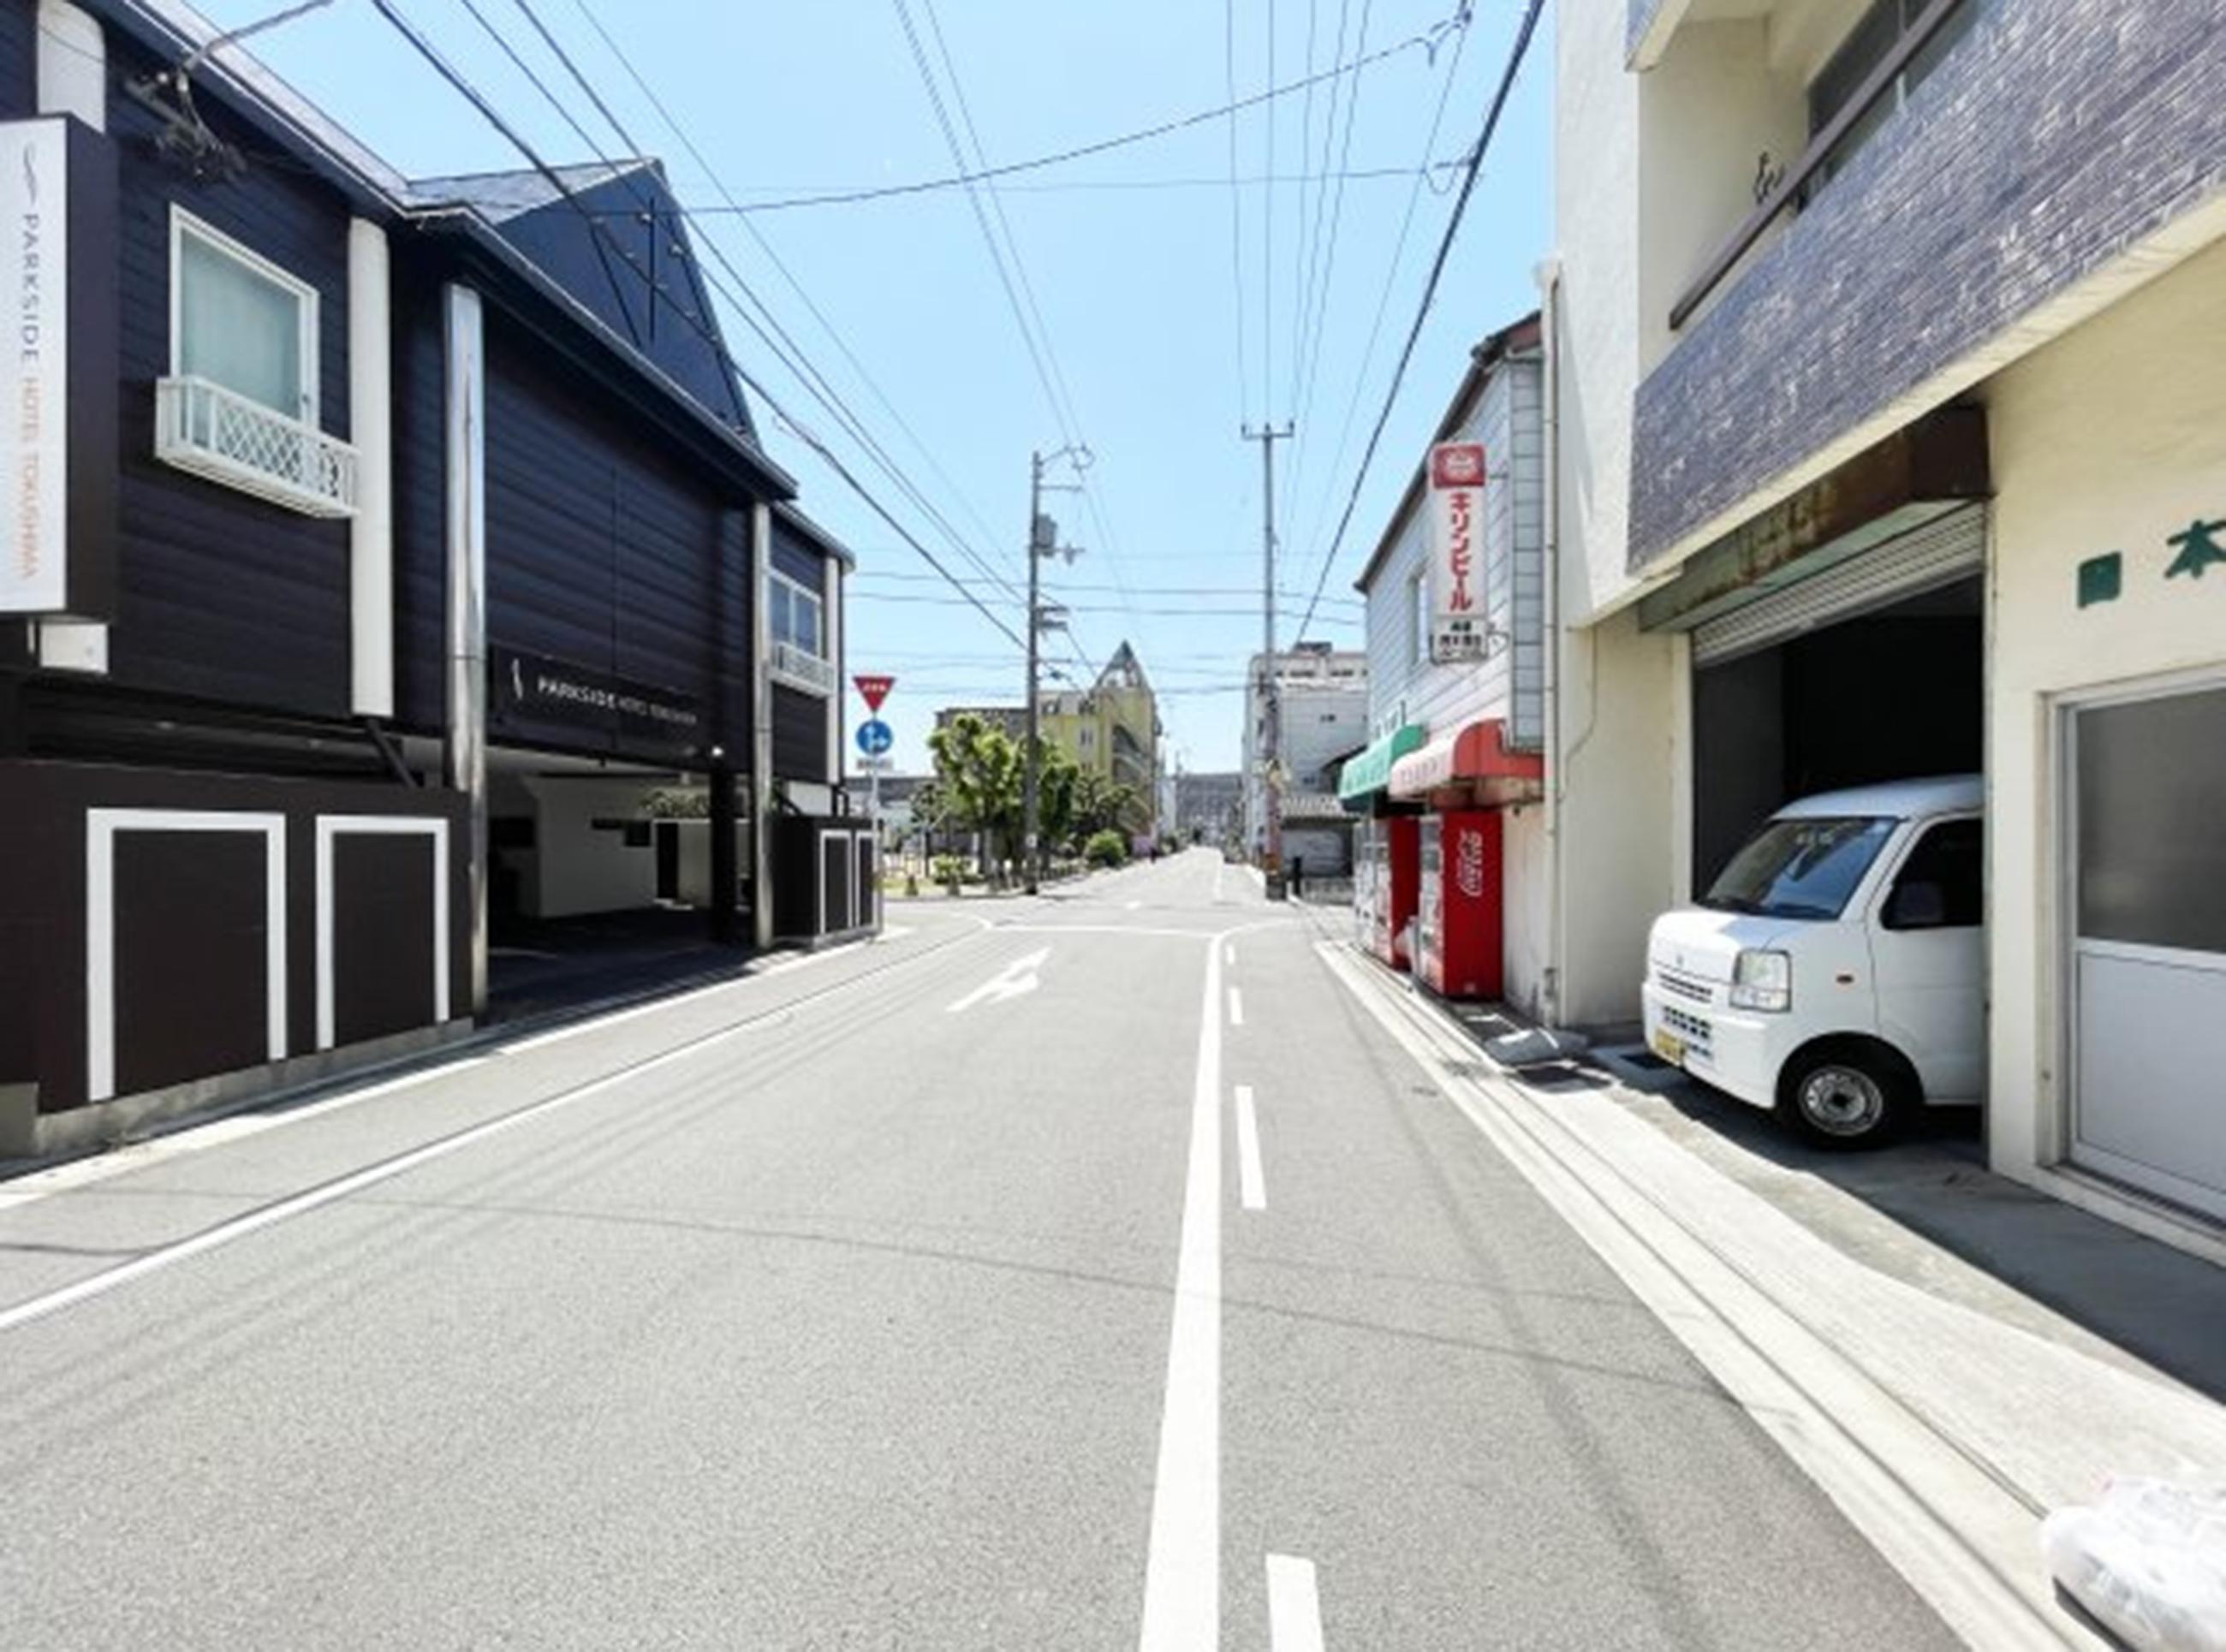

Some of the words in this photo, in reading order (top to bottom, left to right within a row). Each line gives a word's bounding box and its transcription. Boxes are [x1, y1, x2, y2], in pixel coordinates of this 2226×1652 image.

[22, 213, 39, 364] PARKSIDE
[1449, 493, 1473, 611] キリンビール
